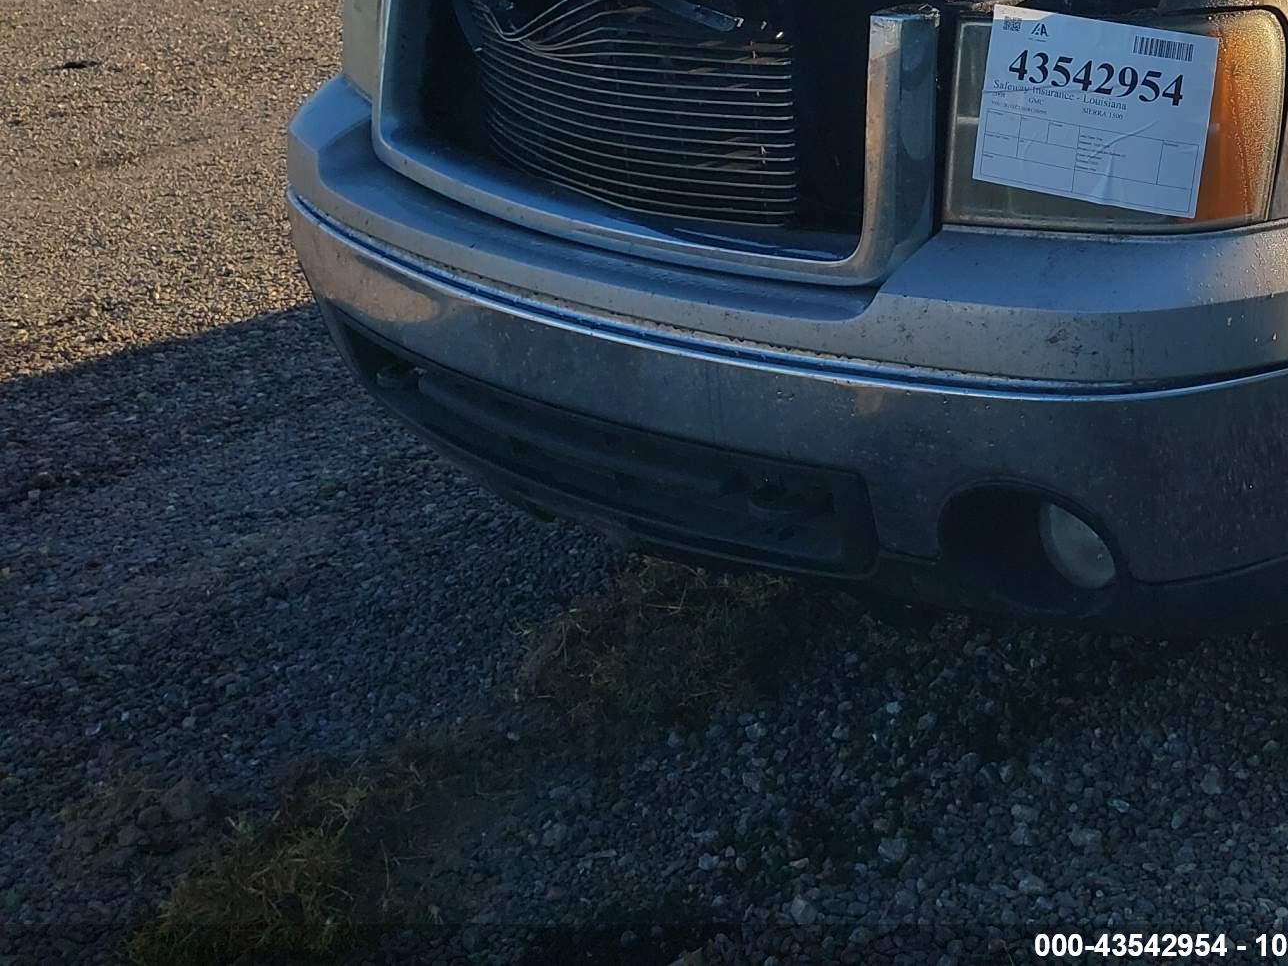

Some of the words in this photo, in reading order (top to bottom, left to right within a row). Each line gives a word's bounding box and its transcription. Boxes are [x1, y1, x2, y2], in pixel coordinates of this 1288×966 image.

[993, 79, 1029, 94] Safeway
[1031, 86, 1075, 102] Insurance
[1082, 94, 1127, 111] Louisiana
[1008, 49, 1184, 107] 43542954
